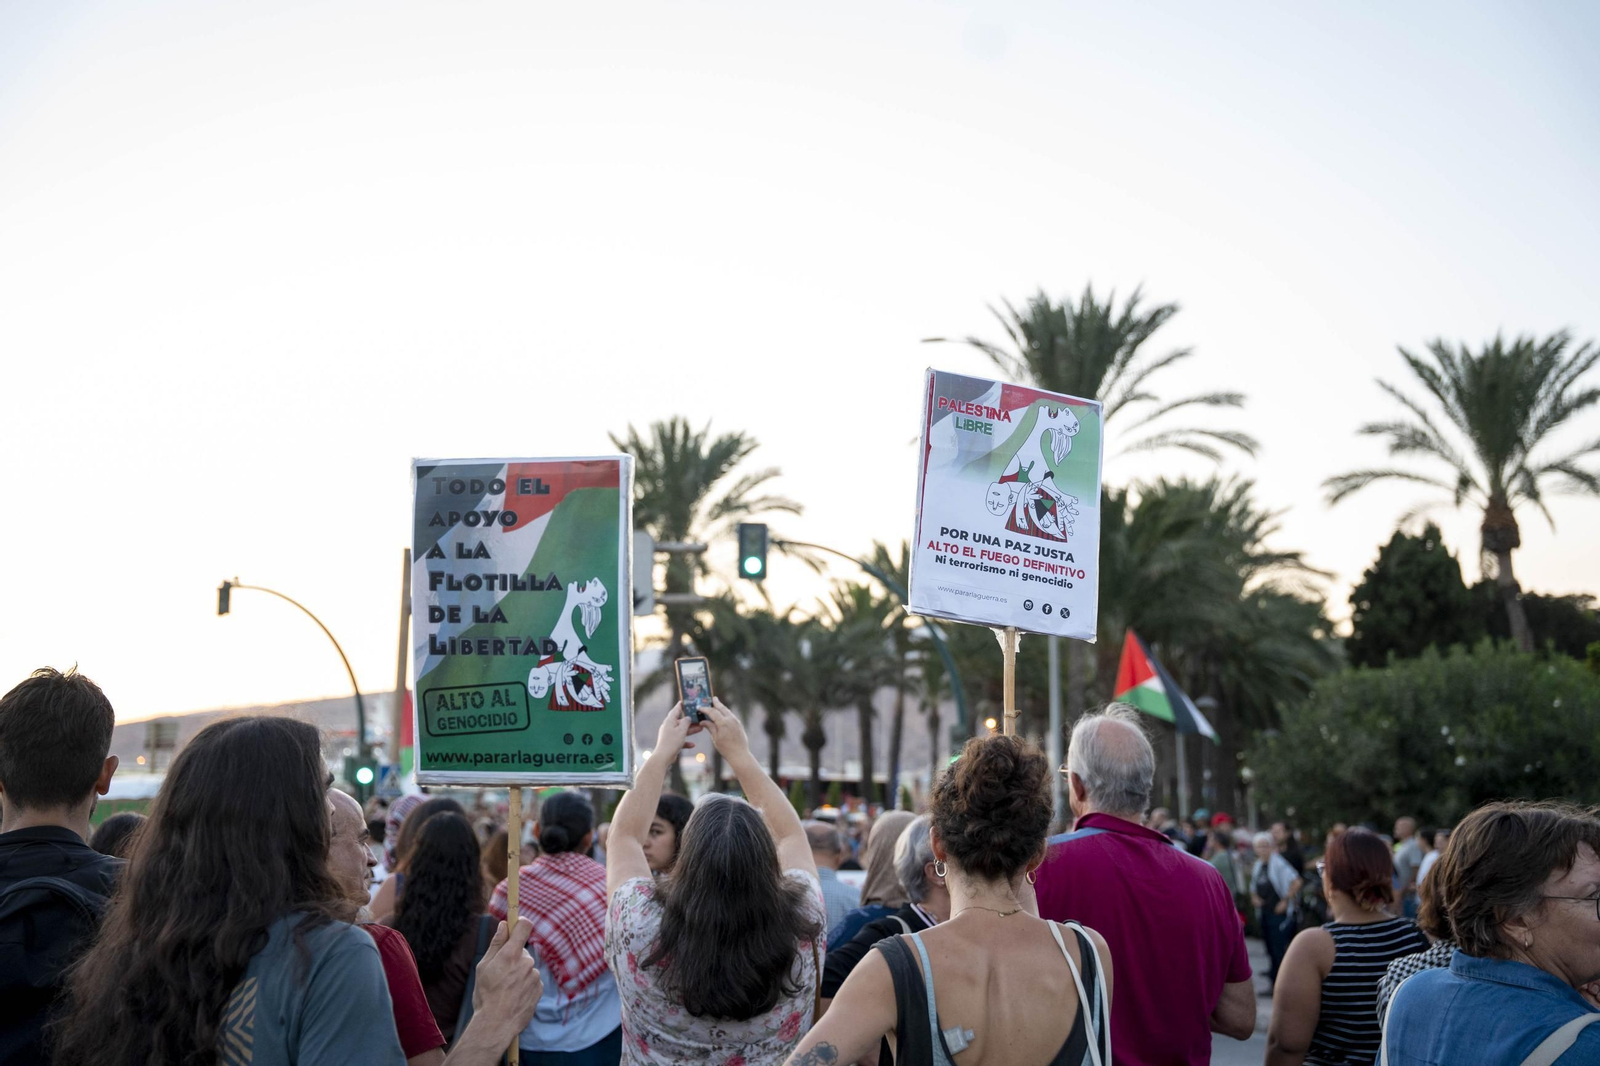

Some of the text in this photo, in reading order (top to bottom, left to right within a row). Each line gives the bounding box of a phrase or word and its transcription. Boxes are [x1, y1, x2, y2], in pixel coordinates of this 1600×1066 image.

[432, 477, 550, 495] TODO EL
[428, 510, 518, 527] APOYO
[426, 541, 491, 559] A LA
[940, 526, 1074, 563] POR UNA PAZ JUSTA
[927, 540, 1086, 579] ALTO EL FUEGO DEFINITIVO
[428, 571, 563, 591] FLOTILLA
[935, 554, 1074, 589] Ni terrorismo ni genocidio
[937, 584, 1008, 604] www.pararlaguerra.es
[428, 604, 508, 623] DE LA
[428, 633, 558, 655] LIBERTAD
[436, 689, 517, 712] ALTO AL
[437, 712, 518, 731] GENOCIDIO
[426, 750, 615, 767] www.pararlaguerra.es
